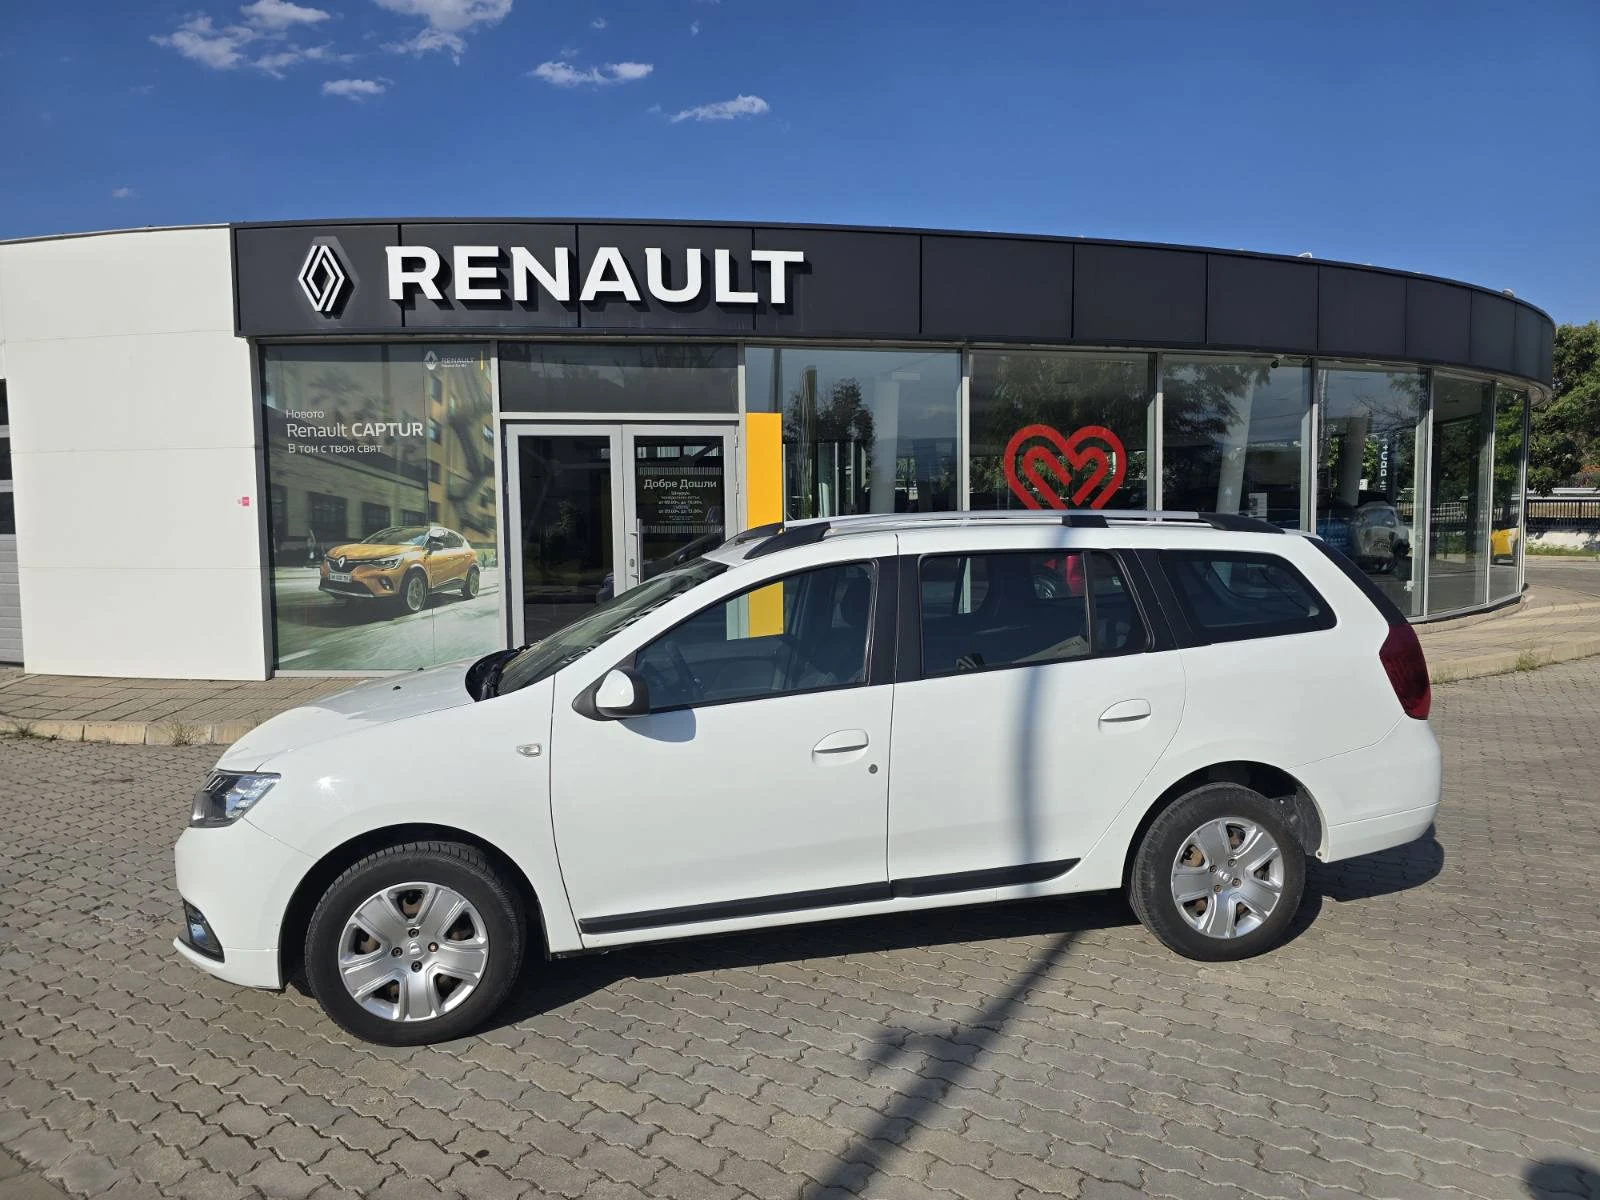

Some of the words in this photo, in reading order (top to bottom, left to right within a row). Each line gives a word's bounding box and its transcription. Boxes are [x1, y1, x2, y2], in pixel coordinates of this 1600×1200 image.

[385, 246, 804, 304] RENAULT
[286, 409, 325, 419] Новото
[286, 422, 348, 438] Renault
[351, 422, 423, 437] CAPTUR
[288, 443, 296, 454] В
[298, 445, 319, 454] тон
[320, 445, 327, 453] с
[329, 445, 355, 454] твоя
[357, 444, 383, 453] свят
[643, 479, 678, 490] Добре
[680, 479, 717, 490] Дошли
